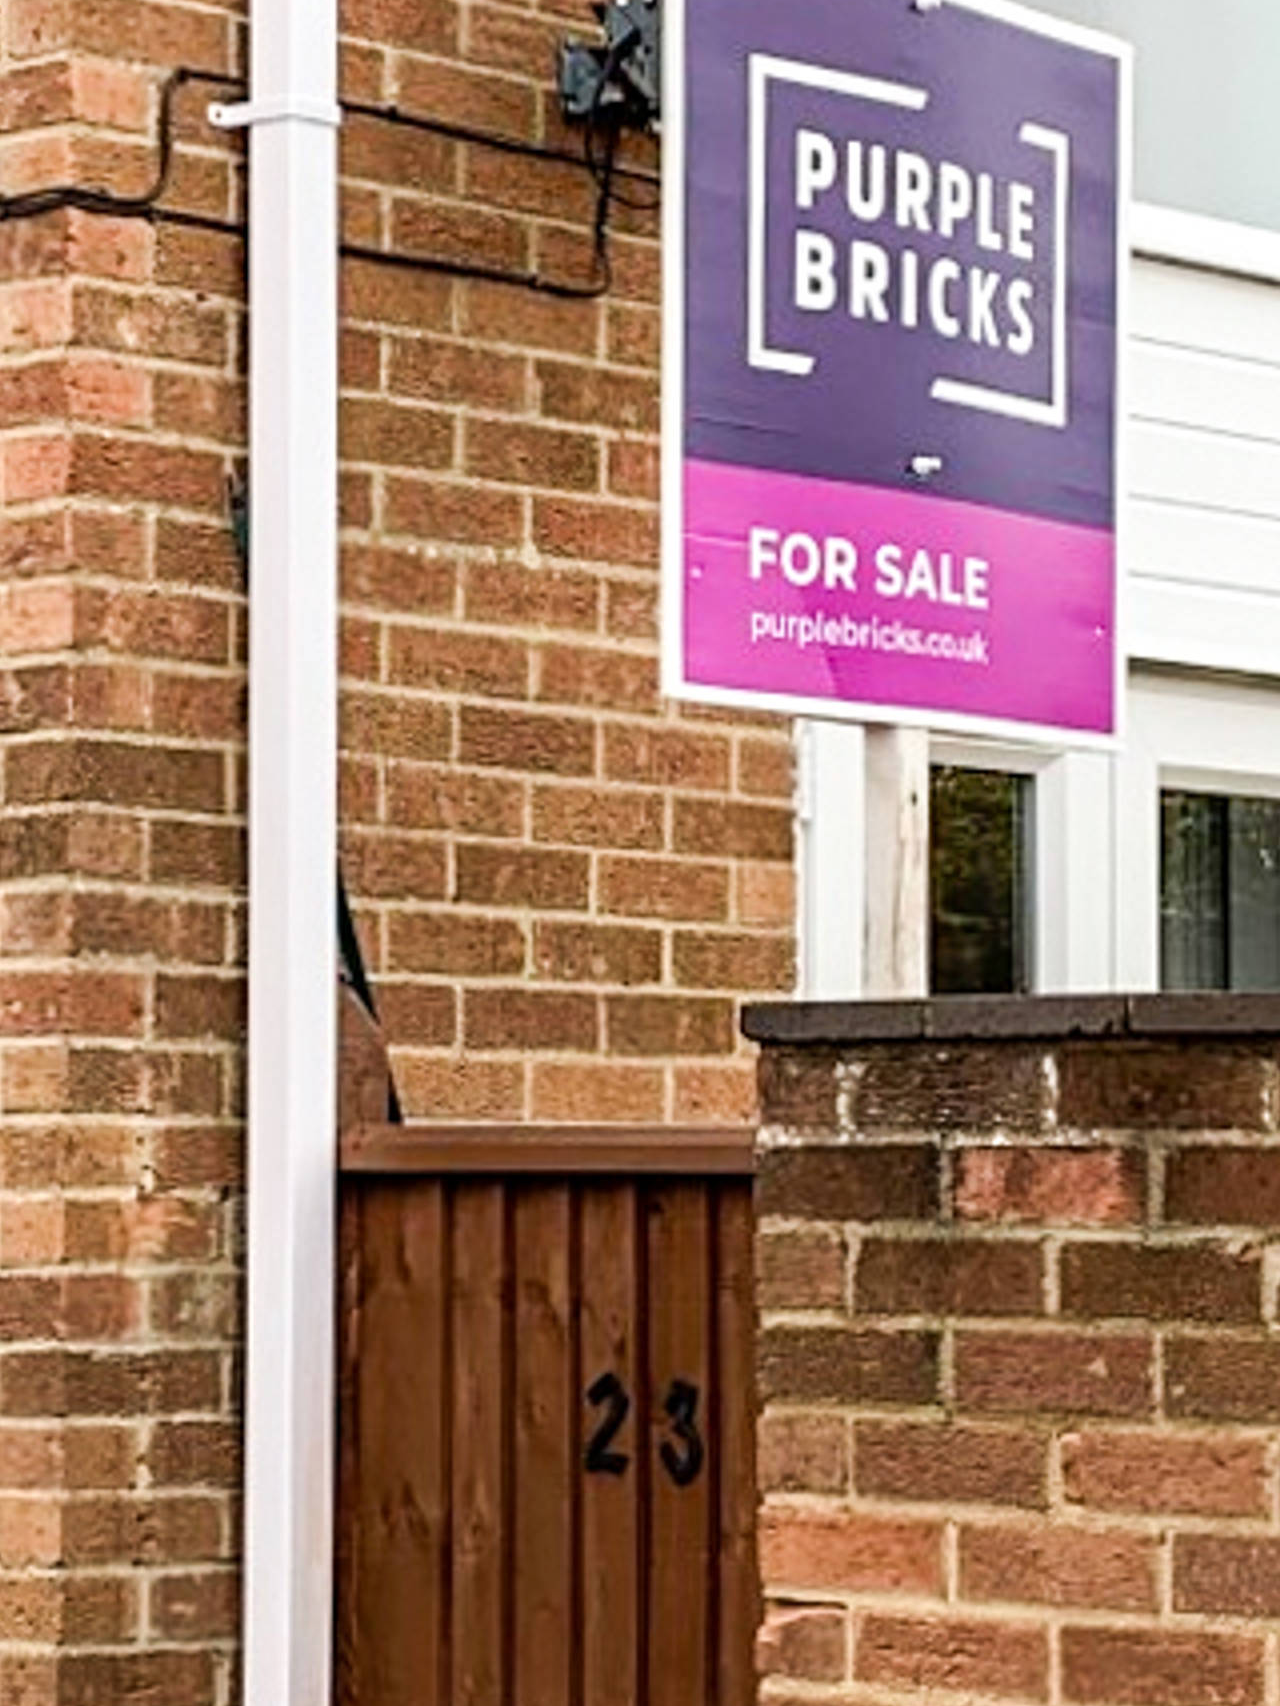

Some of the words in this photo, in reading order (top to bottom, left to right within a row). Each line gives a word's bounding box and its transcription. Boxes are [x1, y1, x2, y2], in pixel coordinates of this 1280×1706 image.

[795, 129, 1034, 259] PURPLE
[794, 232, 1034, 355] BRICKS
[749, 527, 857, 592] FOR
[875, 544, 989, 609] SALE
[750, 609, 989, 665] purplebricks.co.uk
[585, 1371, 704, 1486] 23
